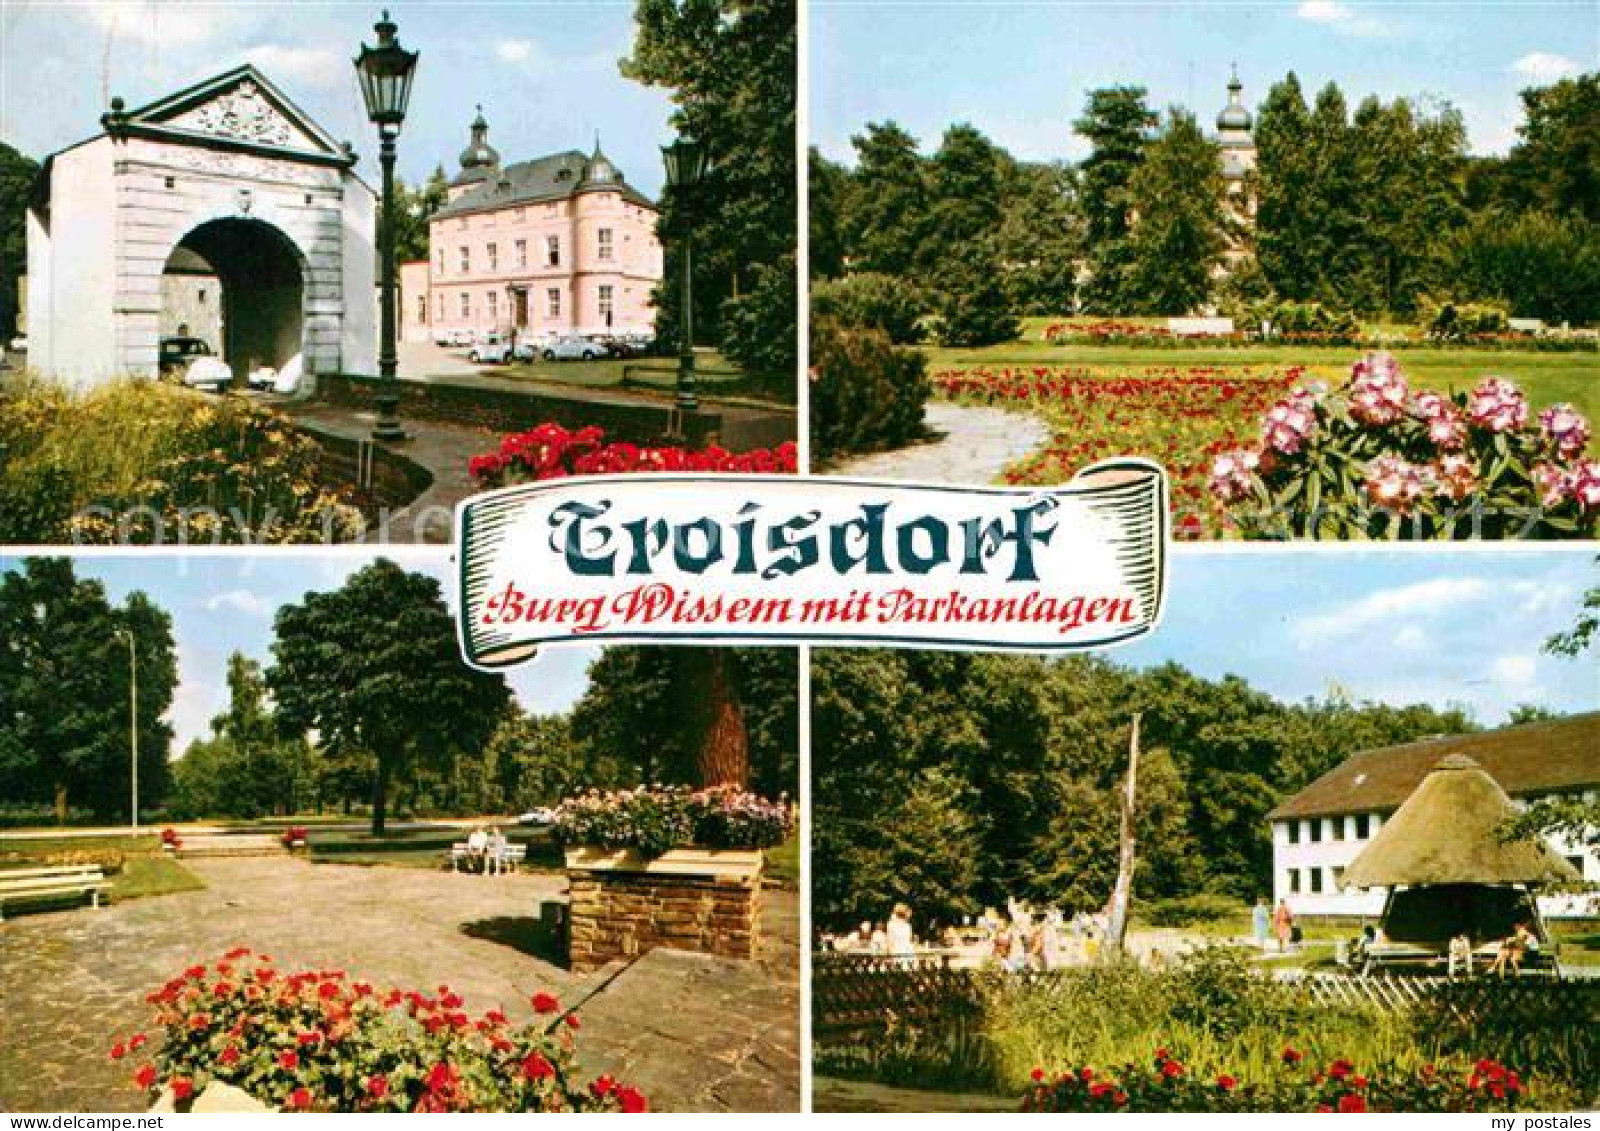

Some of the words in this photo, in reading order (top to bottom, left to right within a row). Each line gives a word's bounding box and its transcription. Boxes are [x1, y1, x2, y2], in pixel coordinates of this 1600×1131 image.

[547, 492, 1063, 582] Troisdorf
[482, 580, 611, 634] Burg
[611, 582, 793, 624] Wissem
[799, 589, 872, 623] mit
[877, 587, 1135, 634] Parkanlagen
